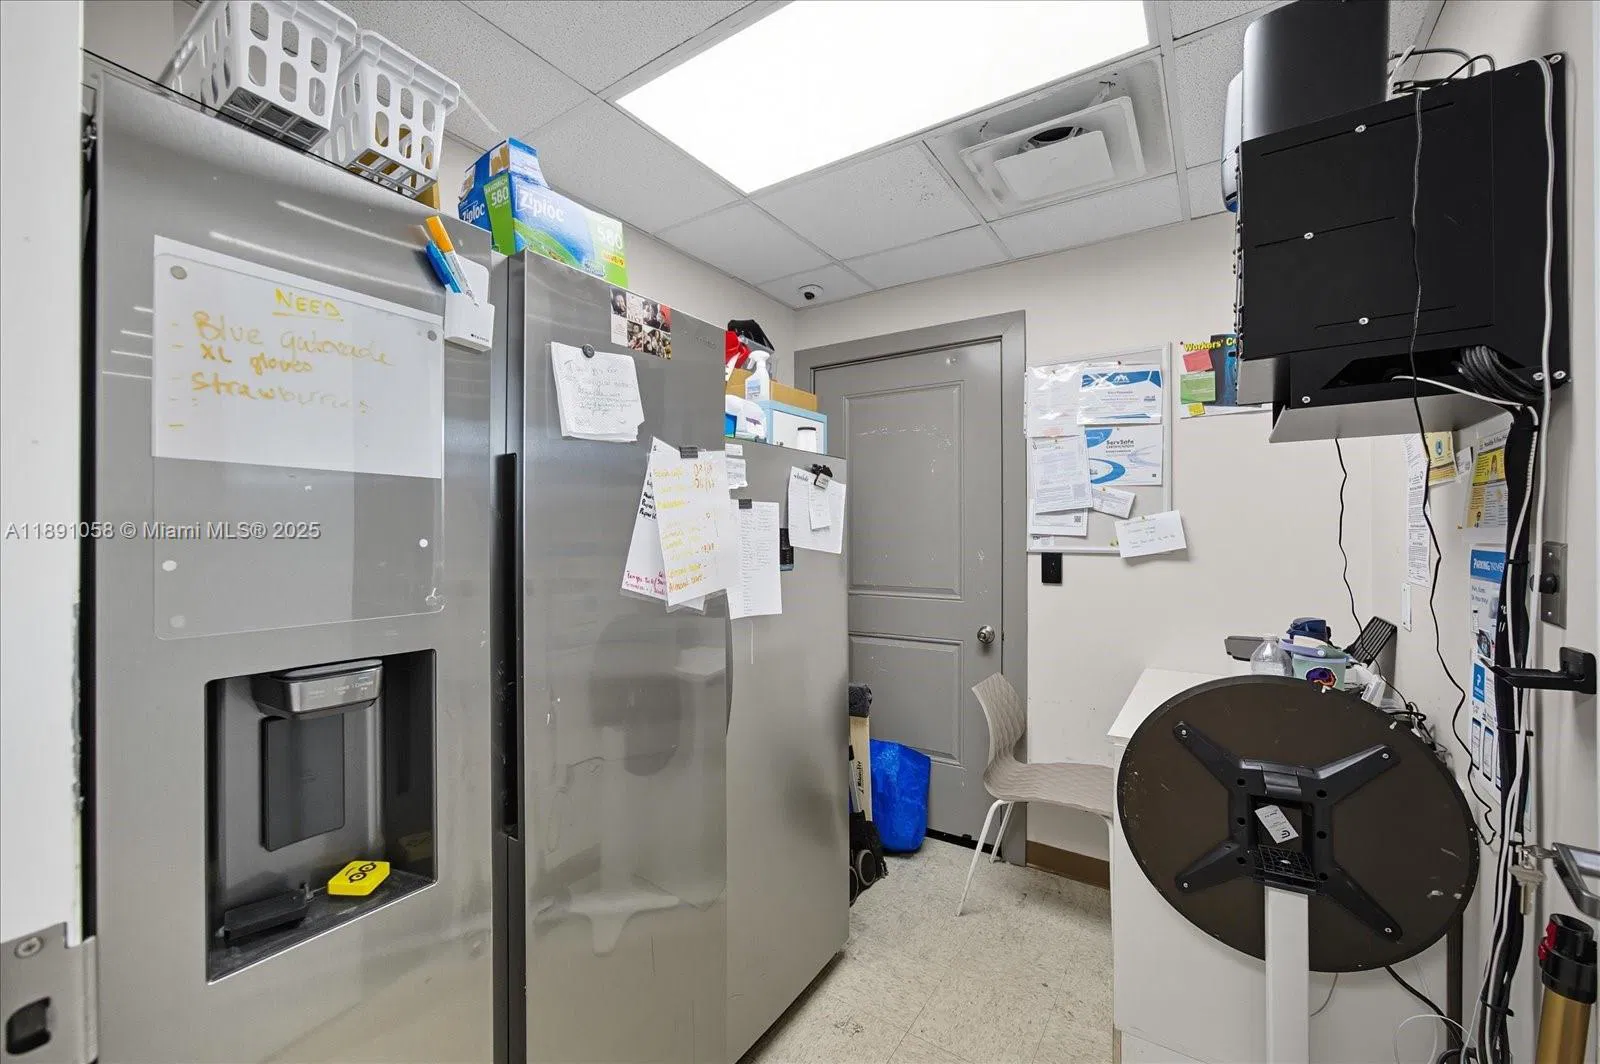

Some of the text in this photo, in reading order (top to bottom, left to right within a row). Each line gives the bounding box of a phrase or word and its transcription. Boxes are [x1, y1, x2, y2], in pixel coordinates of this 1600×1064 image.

[491, 187, 509, 206] 580
[519, 188, 565, 222] Ziploc
[597, 222, 623, 249] 580
[275, 287, 341, 317] NEED
[192, 310, 264, 346] Blue
[200, 343, 313, 375] XL gloves
